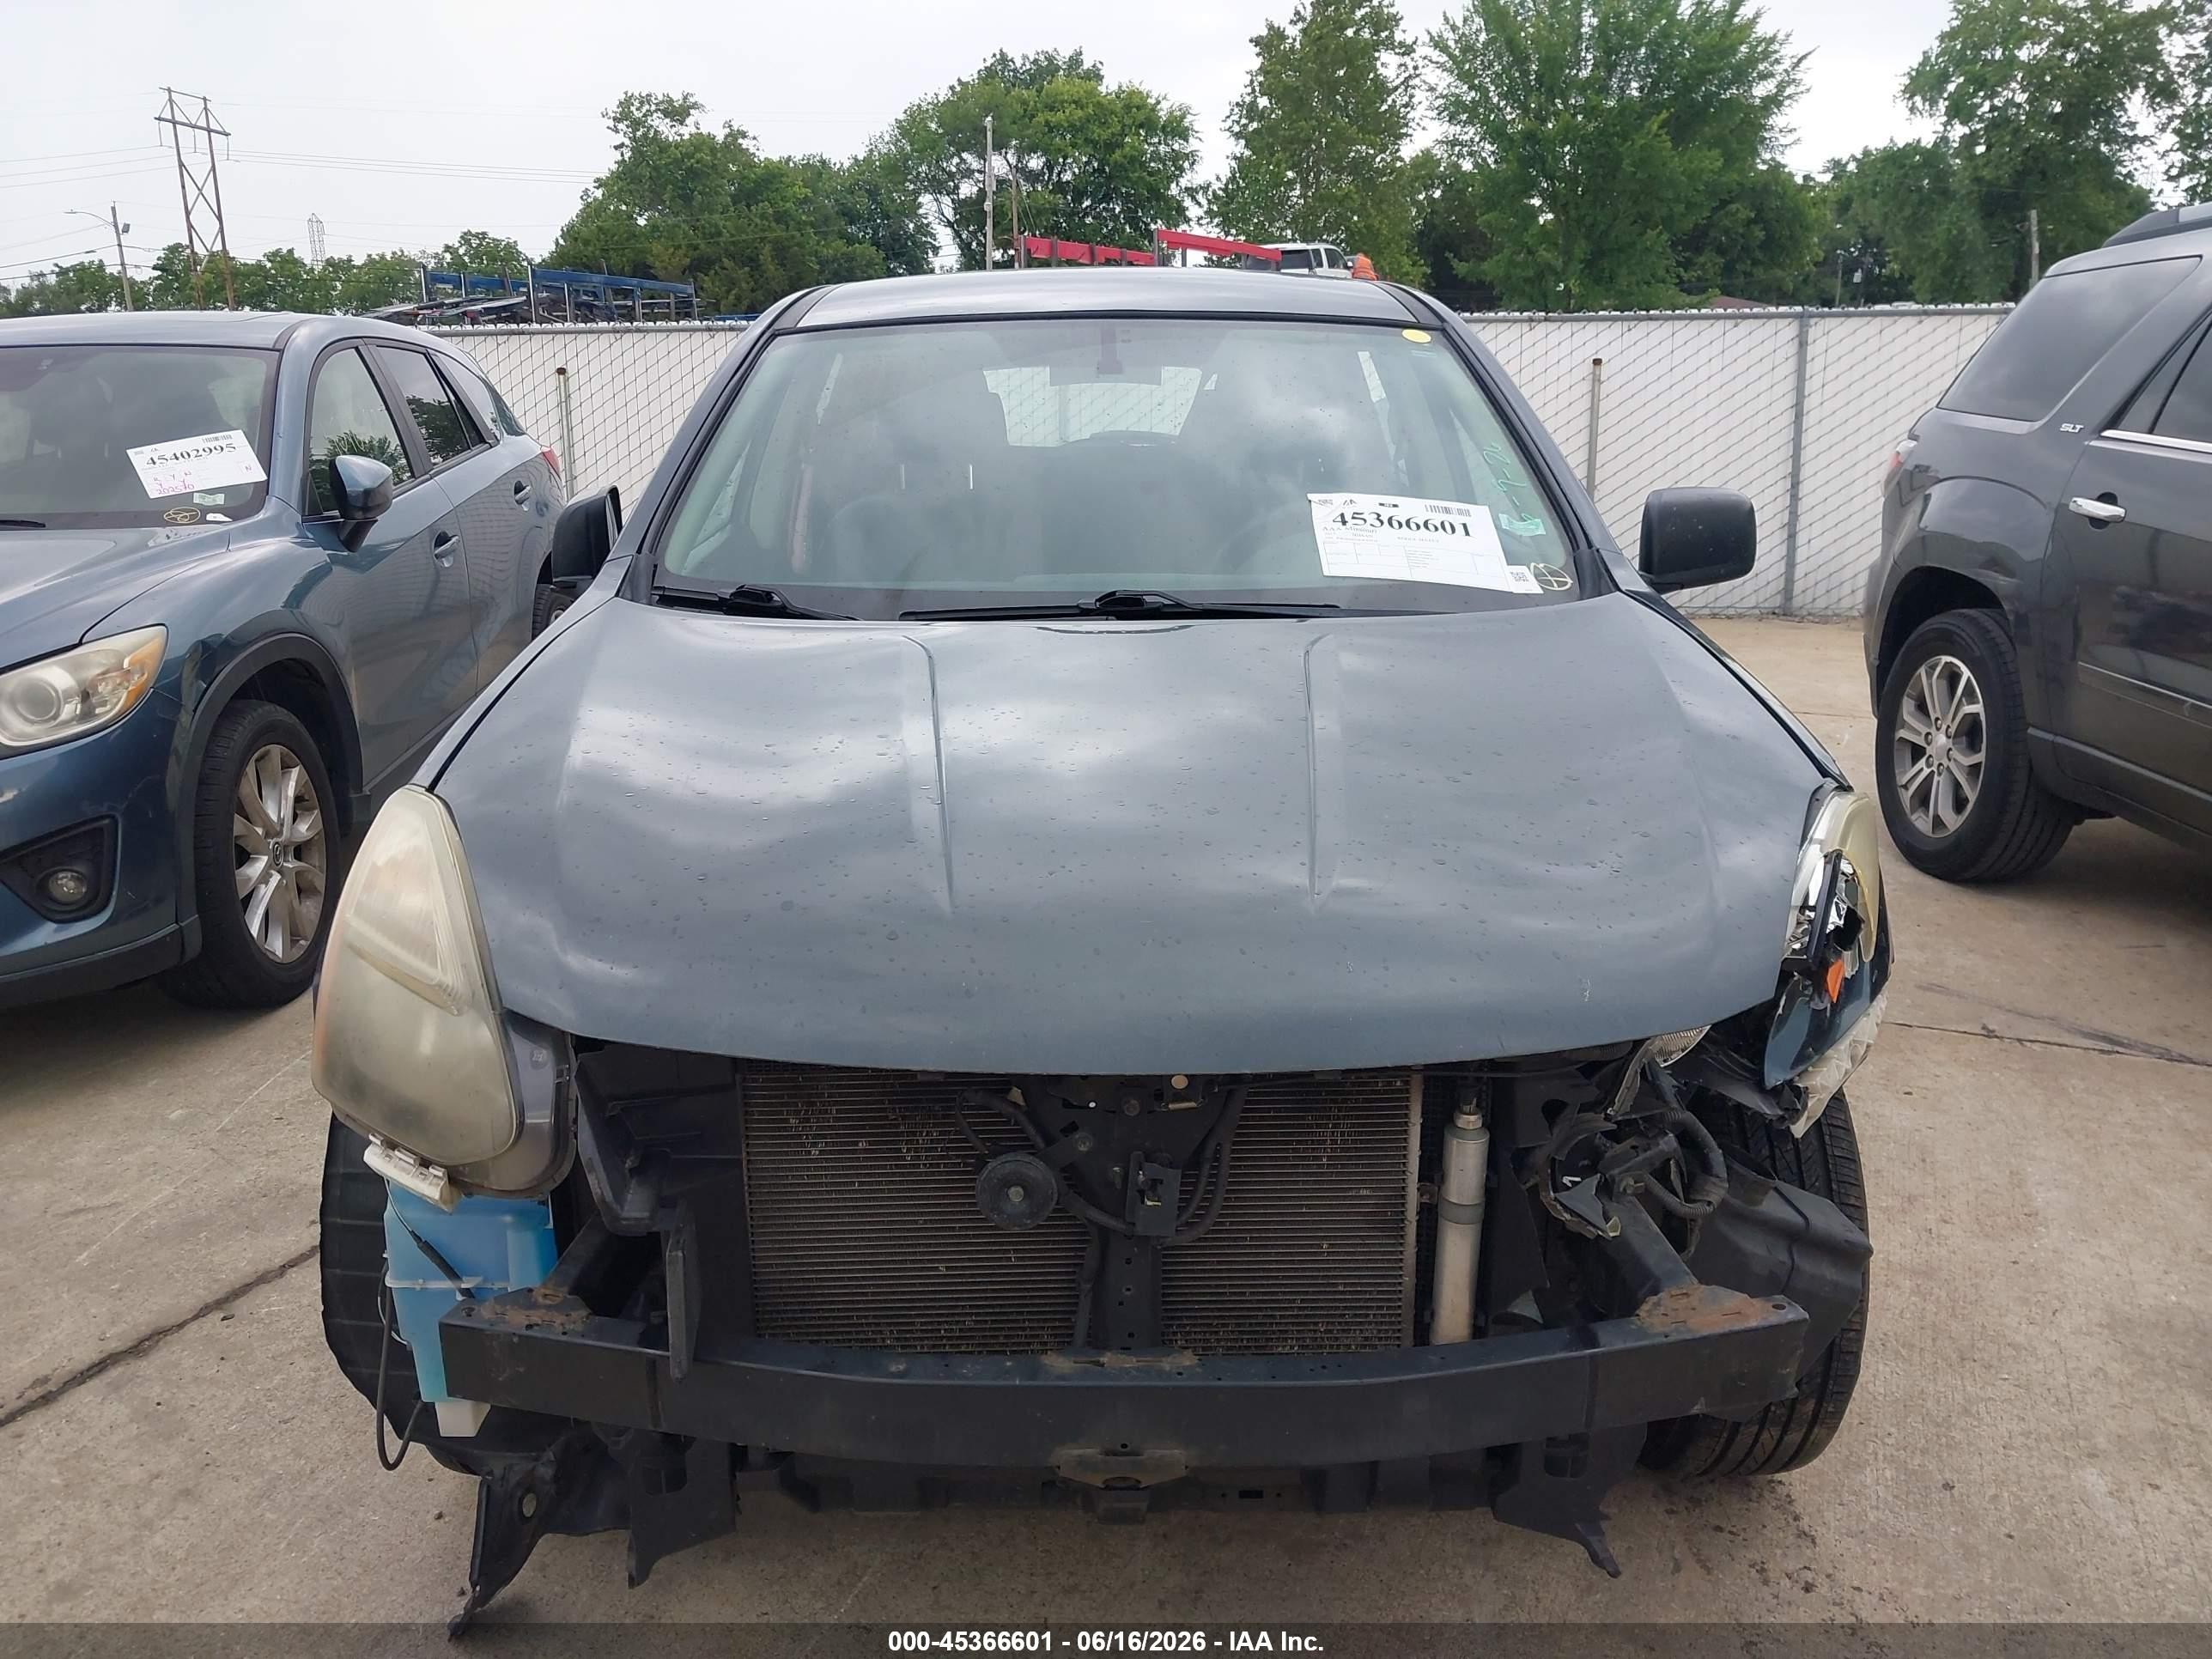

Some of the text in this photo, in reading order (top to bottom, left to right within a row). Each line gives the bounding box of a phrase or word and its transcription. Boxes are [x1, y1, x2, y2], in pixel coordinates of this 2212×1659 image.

[2059, 422, 2084, 433] SLT
[145, 442, 237, 466] 45402995
[1332, 511, 1475, 538] 45366601
